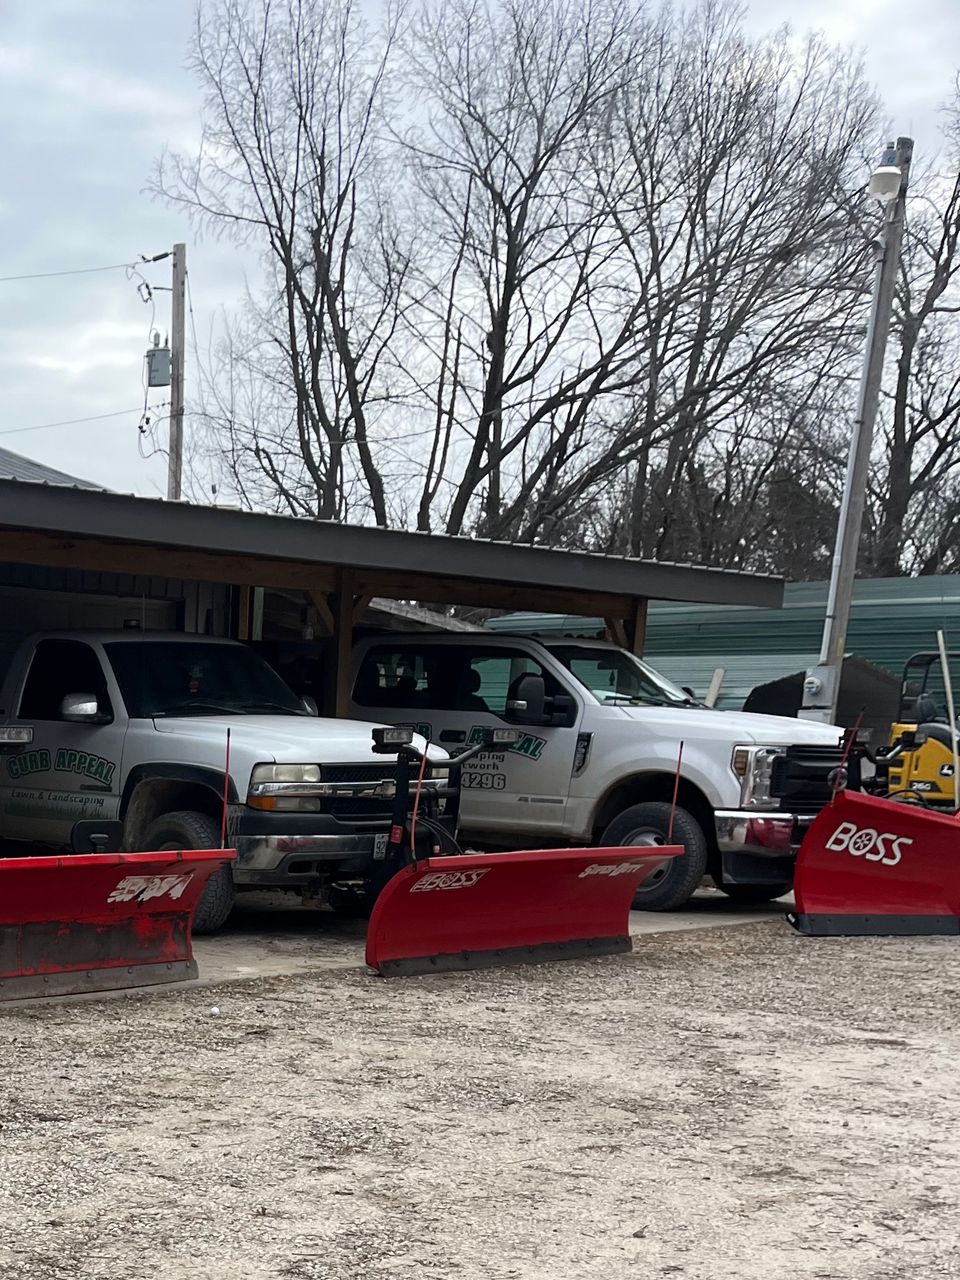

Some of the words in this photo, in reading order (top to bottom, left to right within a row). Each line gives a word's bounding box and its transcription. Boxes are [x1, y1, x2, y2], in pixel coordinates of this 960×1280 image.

[7, 748, 51, 779] CURB
[54, 748, 116, 785] APPEAL
[461, 772, 506, 790] 4296
[11, 789, 36, 801] Lawn
[47, 791, 105, 807] Landscaping
[825, 822, 913, 865] BOSS
[423, 870, 484, 889] BOSS
